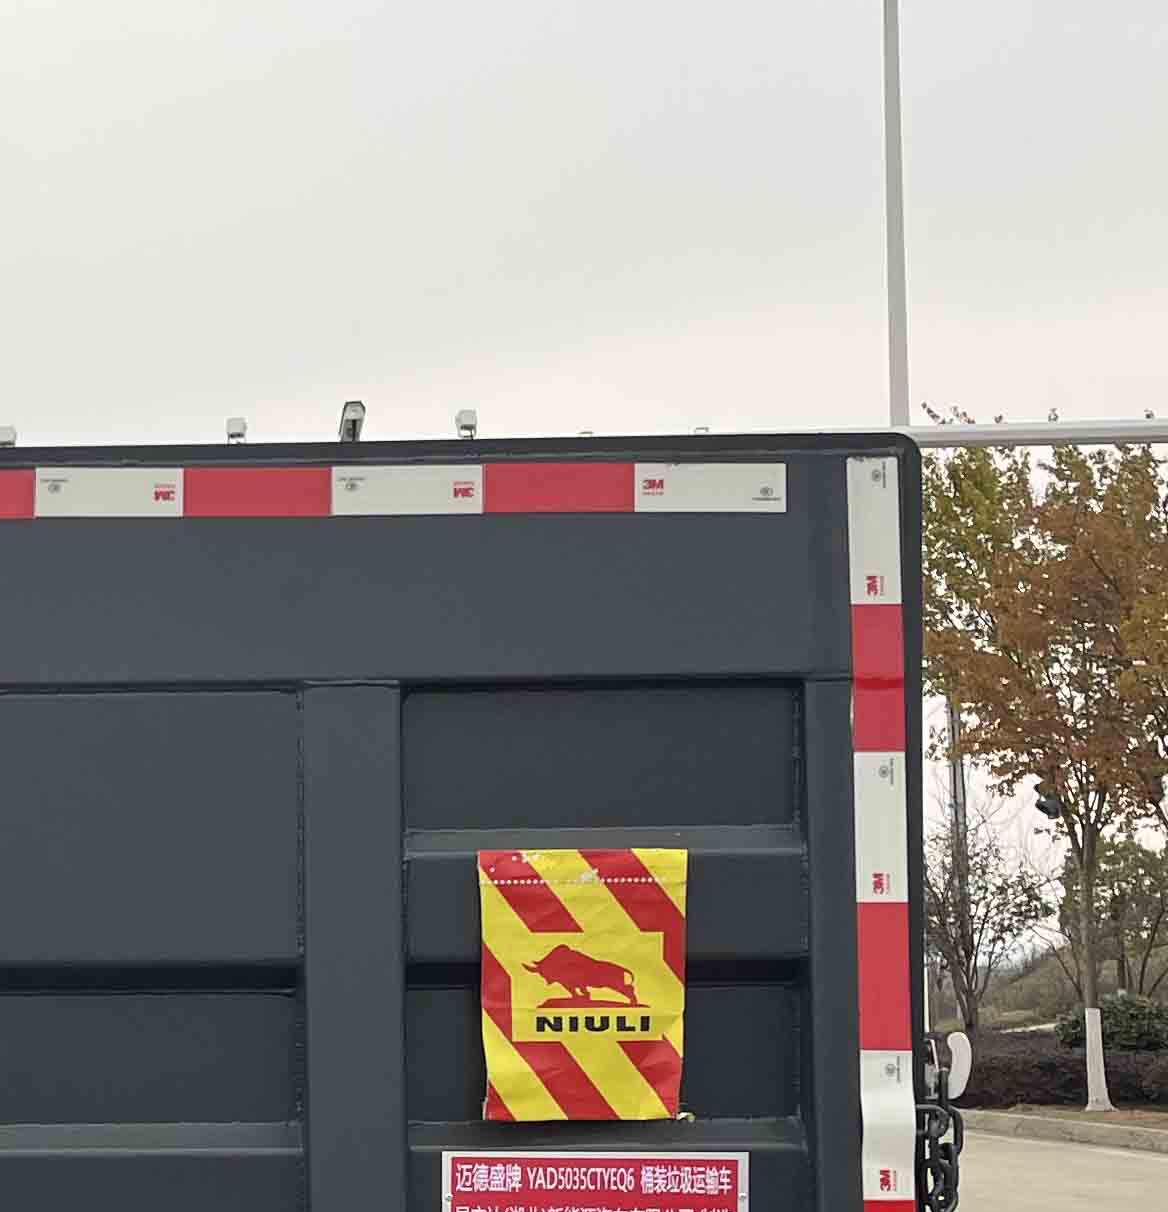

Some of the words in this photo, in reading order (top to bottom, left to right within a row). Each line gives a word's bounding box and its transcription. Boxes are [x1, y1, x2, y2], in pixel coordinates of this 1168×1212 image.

[453, 487, 474, 498] 3M
[643, 478, 664, 489] 3M
[154, 490, 176, 501] 3M
[865, 575, 878, 596] 3M
[872, 872, 883, 894] 3M
[536, 1015, 651, 1033] NIULI
[455, 1163, 522, 1192] 迈德盛牌
[526, 1167, 635, 1192] YAD5035CTYEQ6
[640, 1165, 733, 1195] 桶装垃圾运输车
[880, 1169, 890, 1191] 3M
